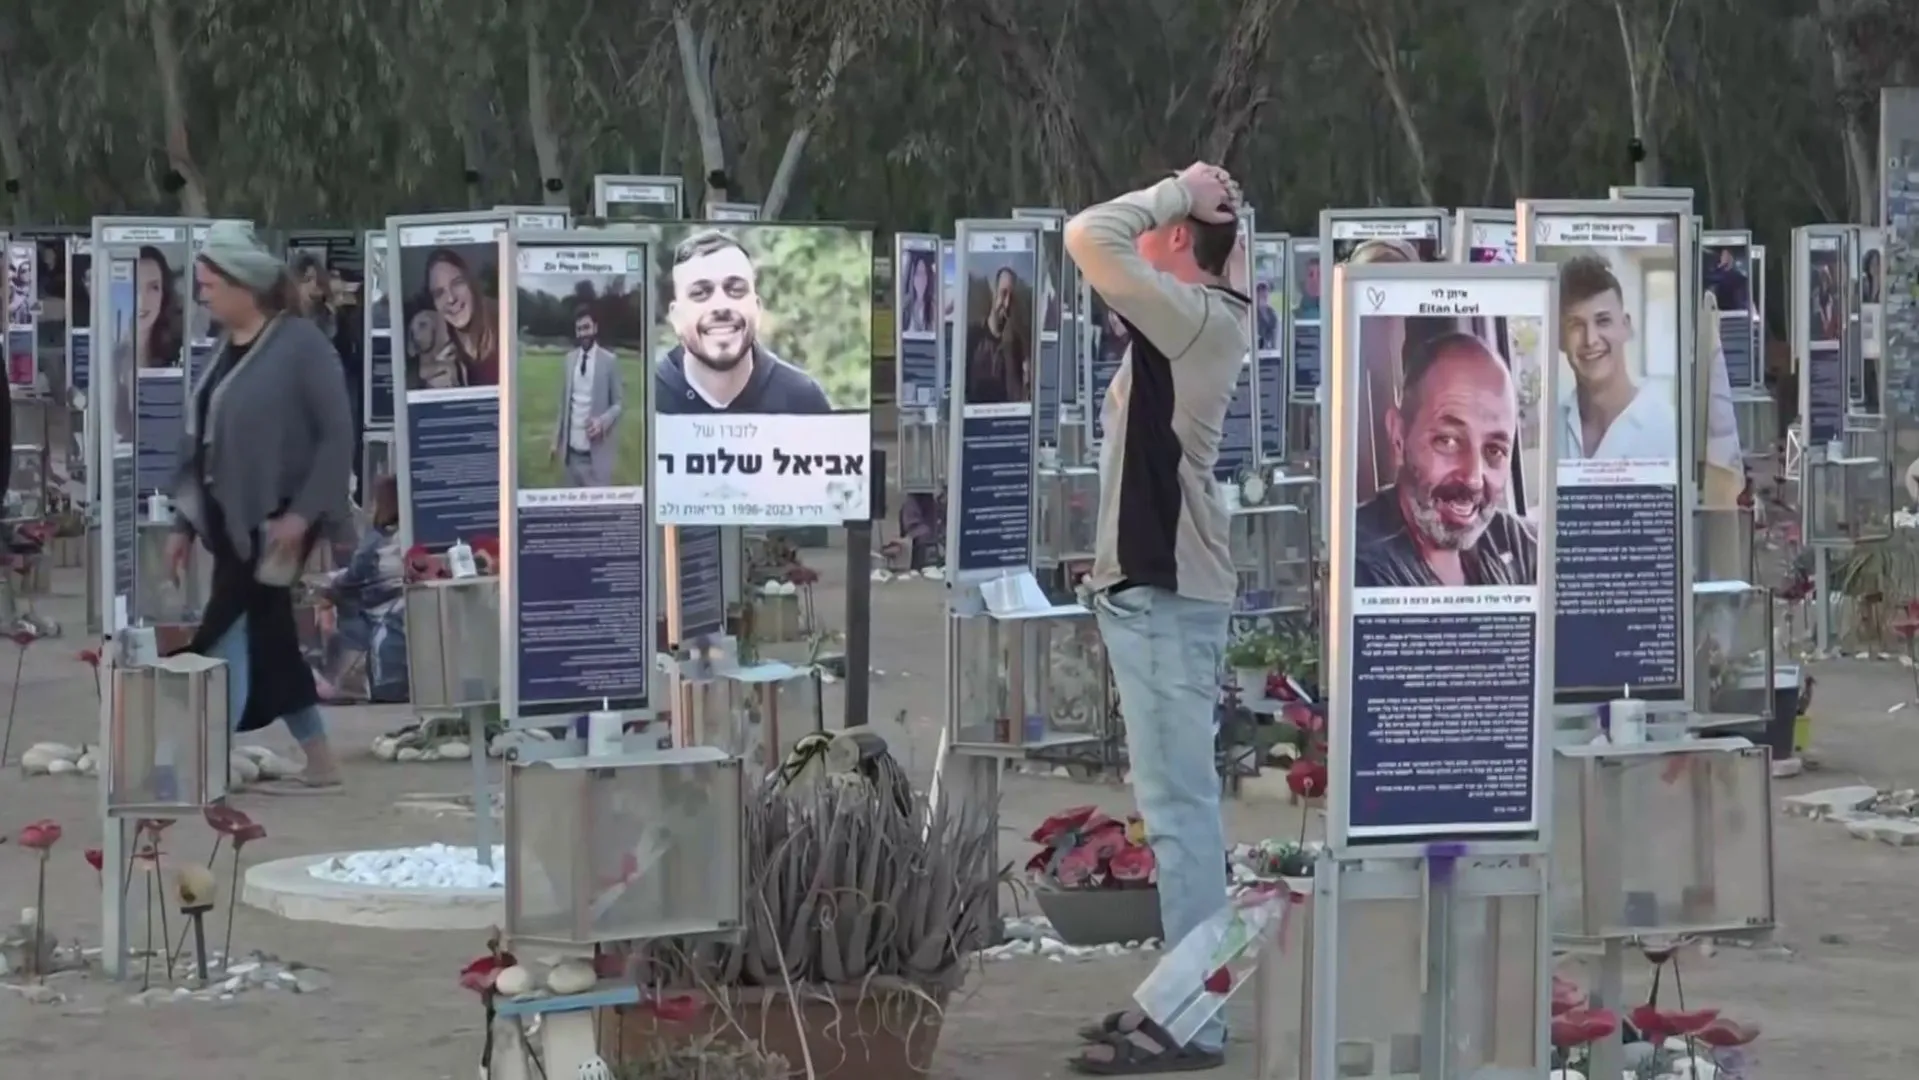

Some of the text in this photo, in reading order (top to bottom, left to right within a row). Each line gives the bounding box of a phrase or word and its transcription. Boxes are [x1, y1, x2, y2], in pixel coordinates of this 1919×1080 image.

[1419, 302, 1479, 313] Eitan Levi
[693, 422, 758, 438] לזכרו של
[686, 447, 763, 475] שלום
[772, 447, 864, 475] אביאל
[732, 504, 793, 516] 1996-2023
